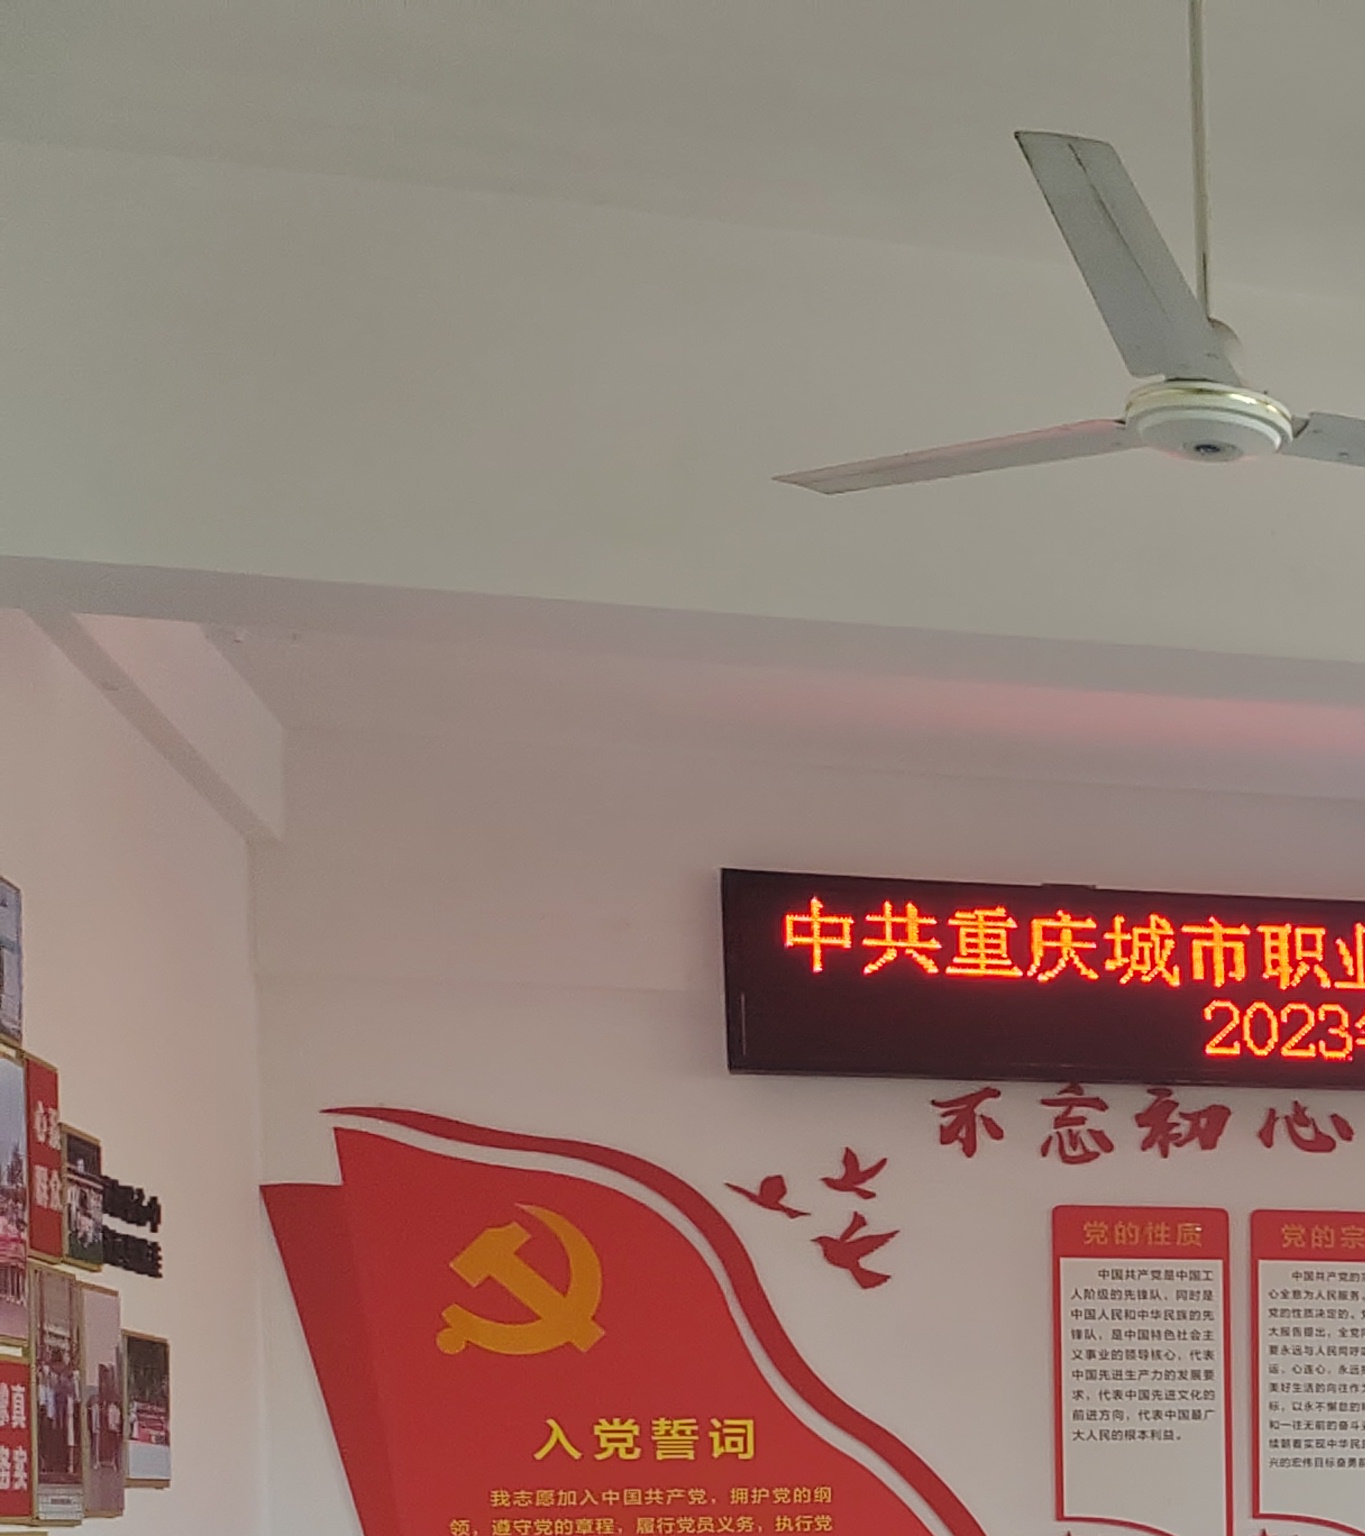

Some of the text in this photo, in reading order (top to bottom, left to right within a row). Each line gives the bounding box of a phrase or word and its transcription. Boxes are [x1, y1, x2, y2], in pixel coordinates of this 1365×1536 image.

[931, 1081, 1356, 1162] 不忘初心
[1083, 1220, 1202, 1247] 党的性质
[534, 1417, 755, 1460] 入党誓词
[491, 1487, 832, 1507] 我志愿加入中国共产党，拥护党的纲
